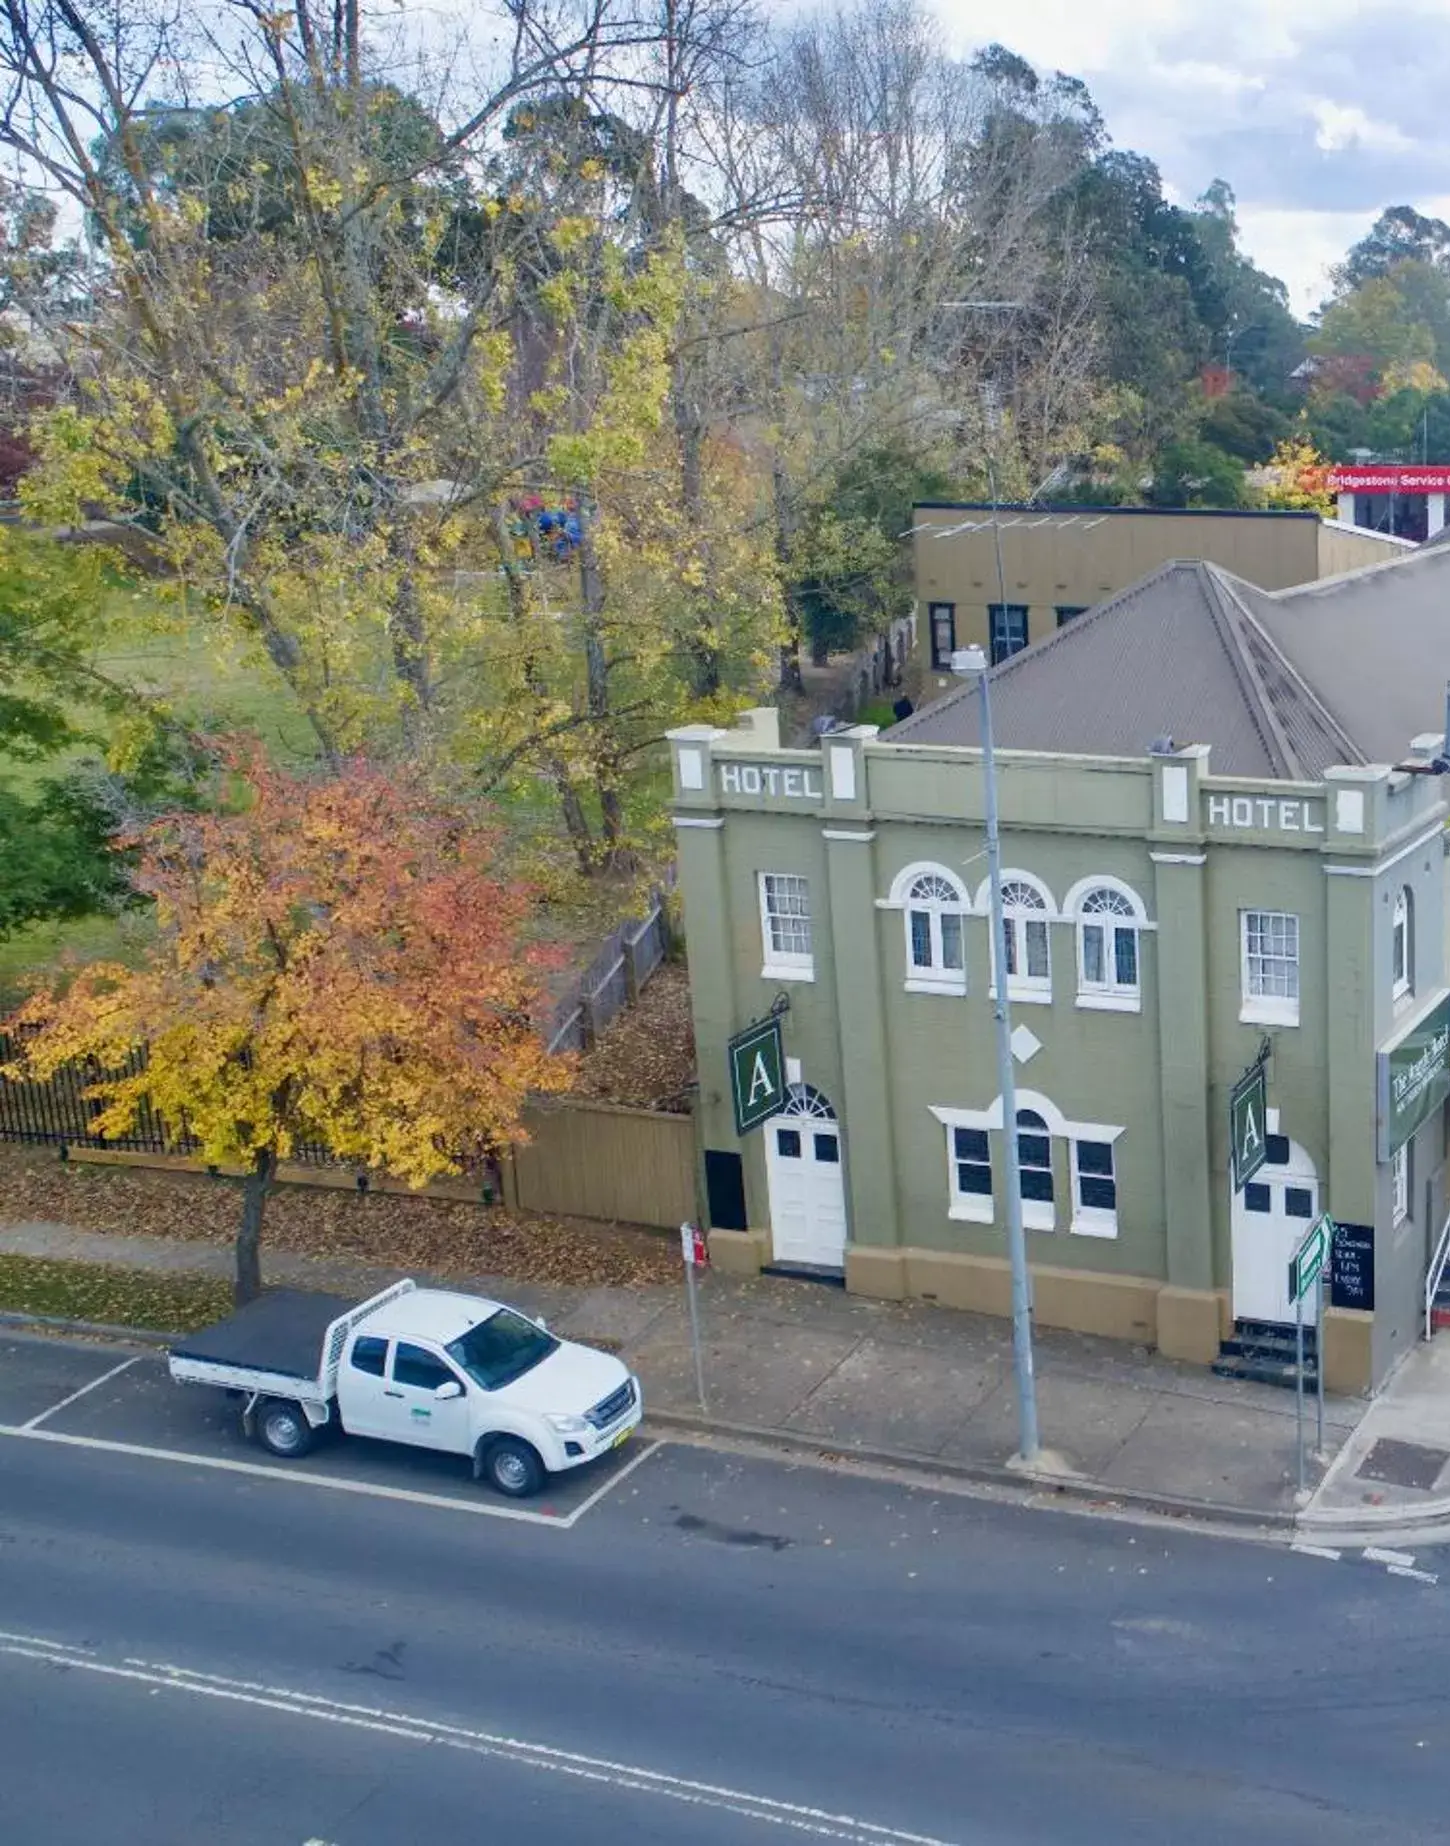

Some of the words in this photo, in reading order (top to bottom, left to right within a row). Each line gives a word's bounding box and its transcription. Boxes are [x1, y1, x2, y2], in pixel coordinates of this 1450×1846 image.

[1327, 474, 1397, 488] Bridgestone
[1400, 474, 1444, 486] Service
[720, 764, 823, 799] HOTEL
[1209, 795, 1325, 833] HOTEL
[748, 1051, 775, 1107] A
[1242, 1101, 1260, 1161] A
